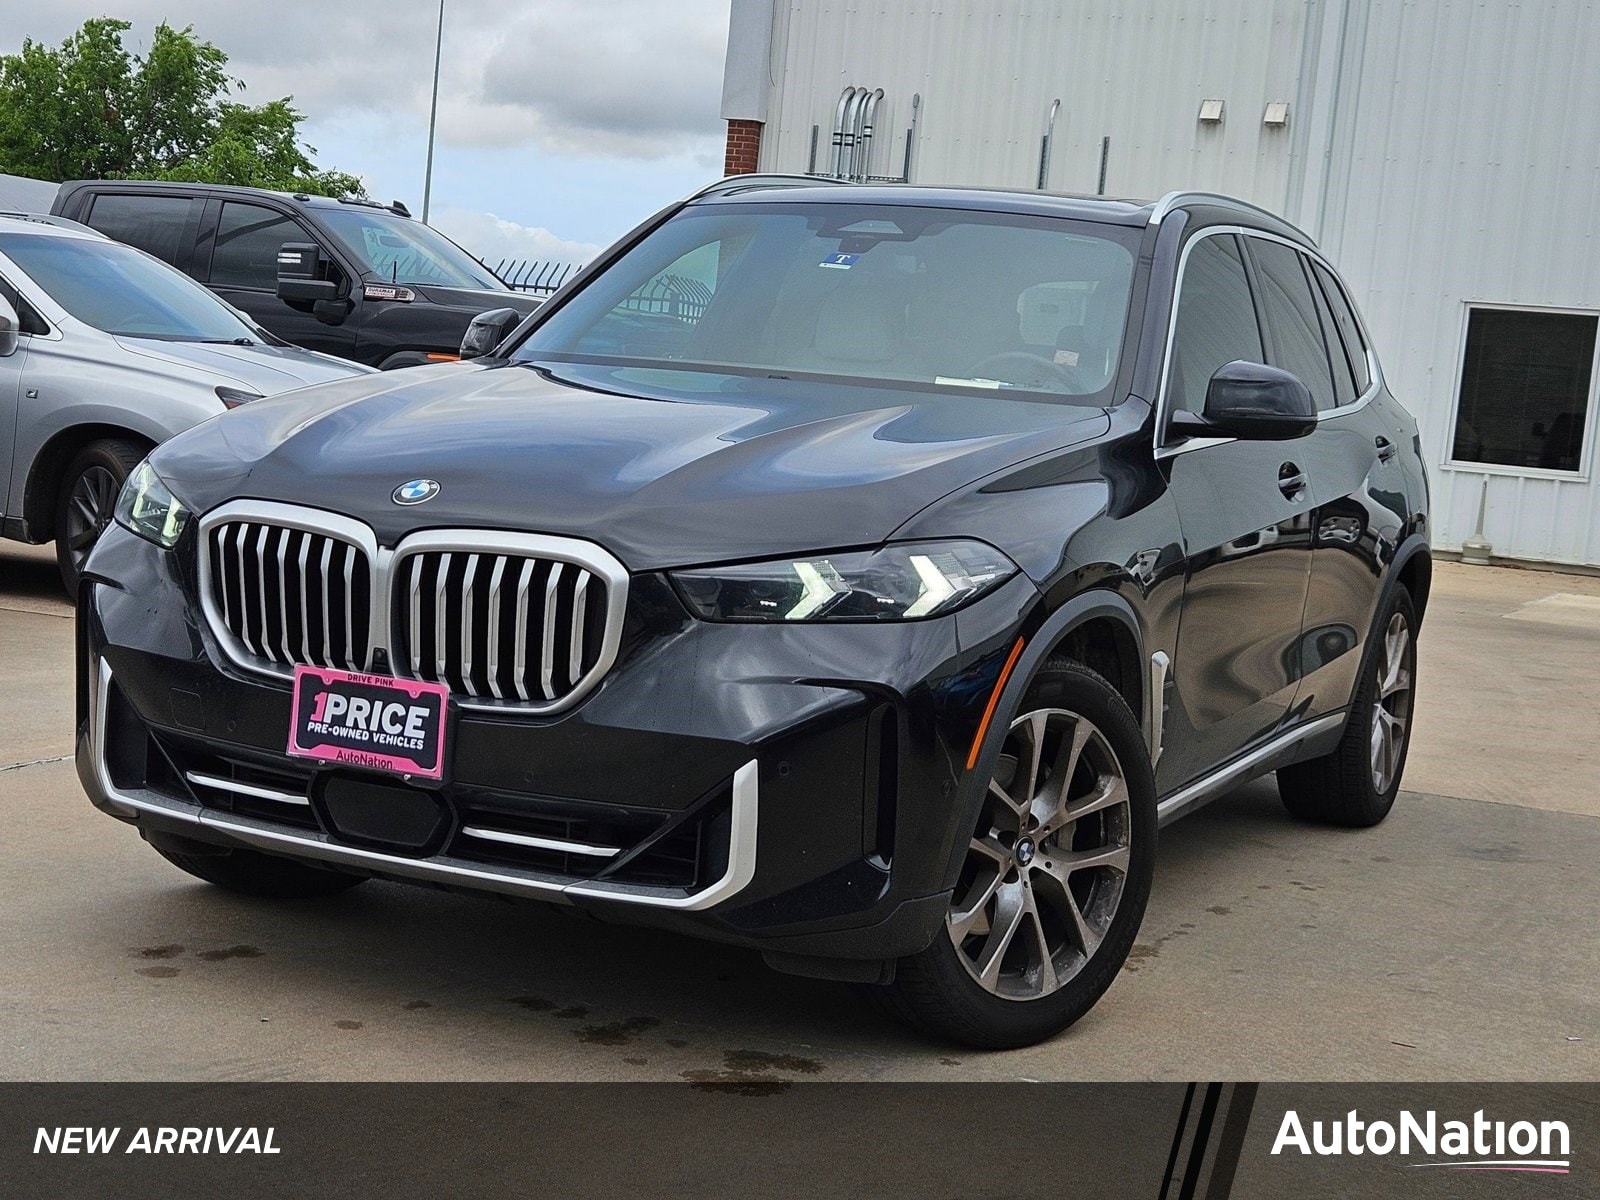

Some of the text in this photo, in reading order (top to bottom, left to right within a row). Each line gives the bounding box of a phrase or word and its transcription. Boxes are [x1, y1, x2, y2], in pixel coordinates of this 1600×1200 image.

[835, 254, 851, 264] T
[347, 673, 394, 687] DRIVE PINK
[307, 721, 424, 750] PRE-OWNED VEHICLES
[336, 750, 393, 769] AutoNation
